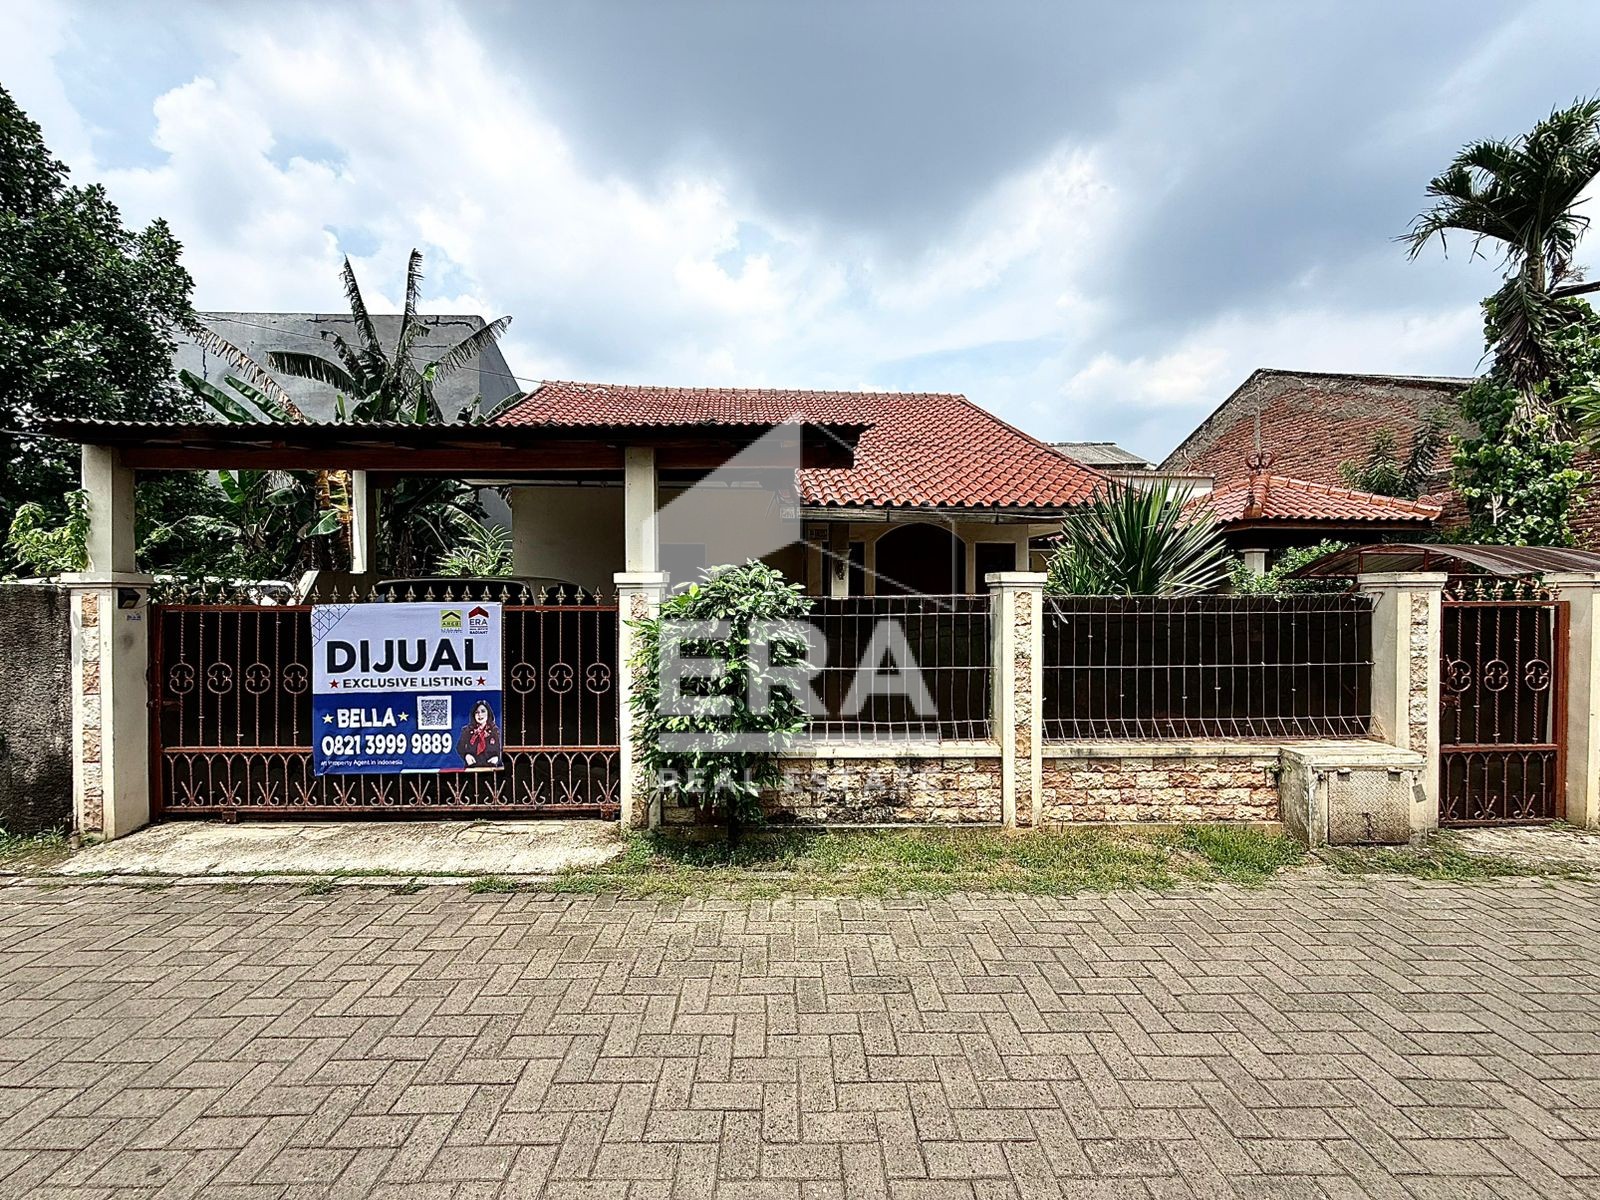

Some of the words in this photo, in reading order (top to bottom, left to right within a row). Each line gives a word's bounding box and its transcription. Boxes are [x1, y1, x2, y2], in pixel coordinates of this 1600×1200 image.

[326, 638, 489, 674] DIJUAL
[342, 677, 418, 689] EXCLUSIVE
[421, 676, 473, 687] LISTING
[337, 707, 397, 729] BELLA
[321, 734, 361, 756] 0821
[365, 733, 407, 756] 3999
[411, 732, 452, 755] 9889
